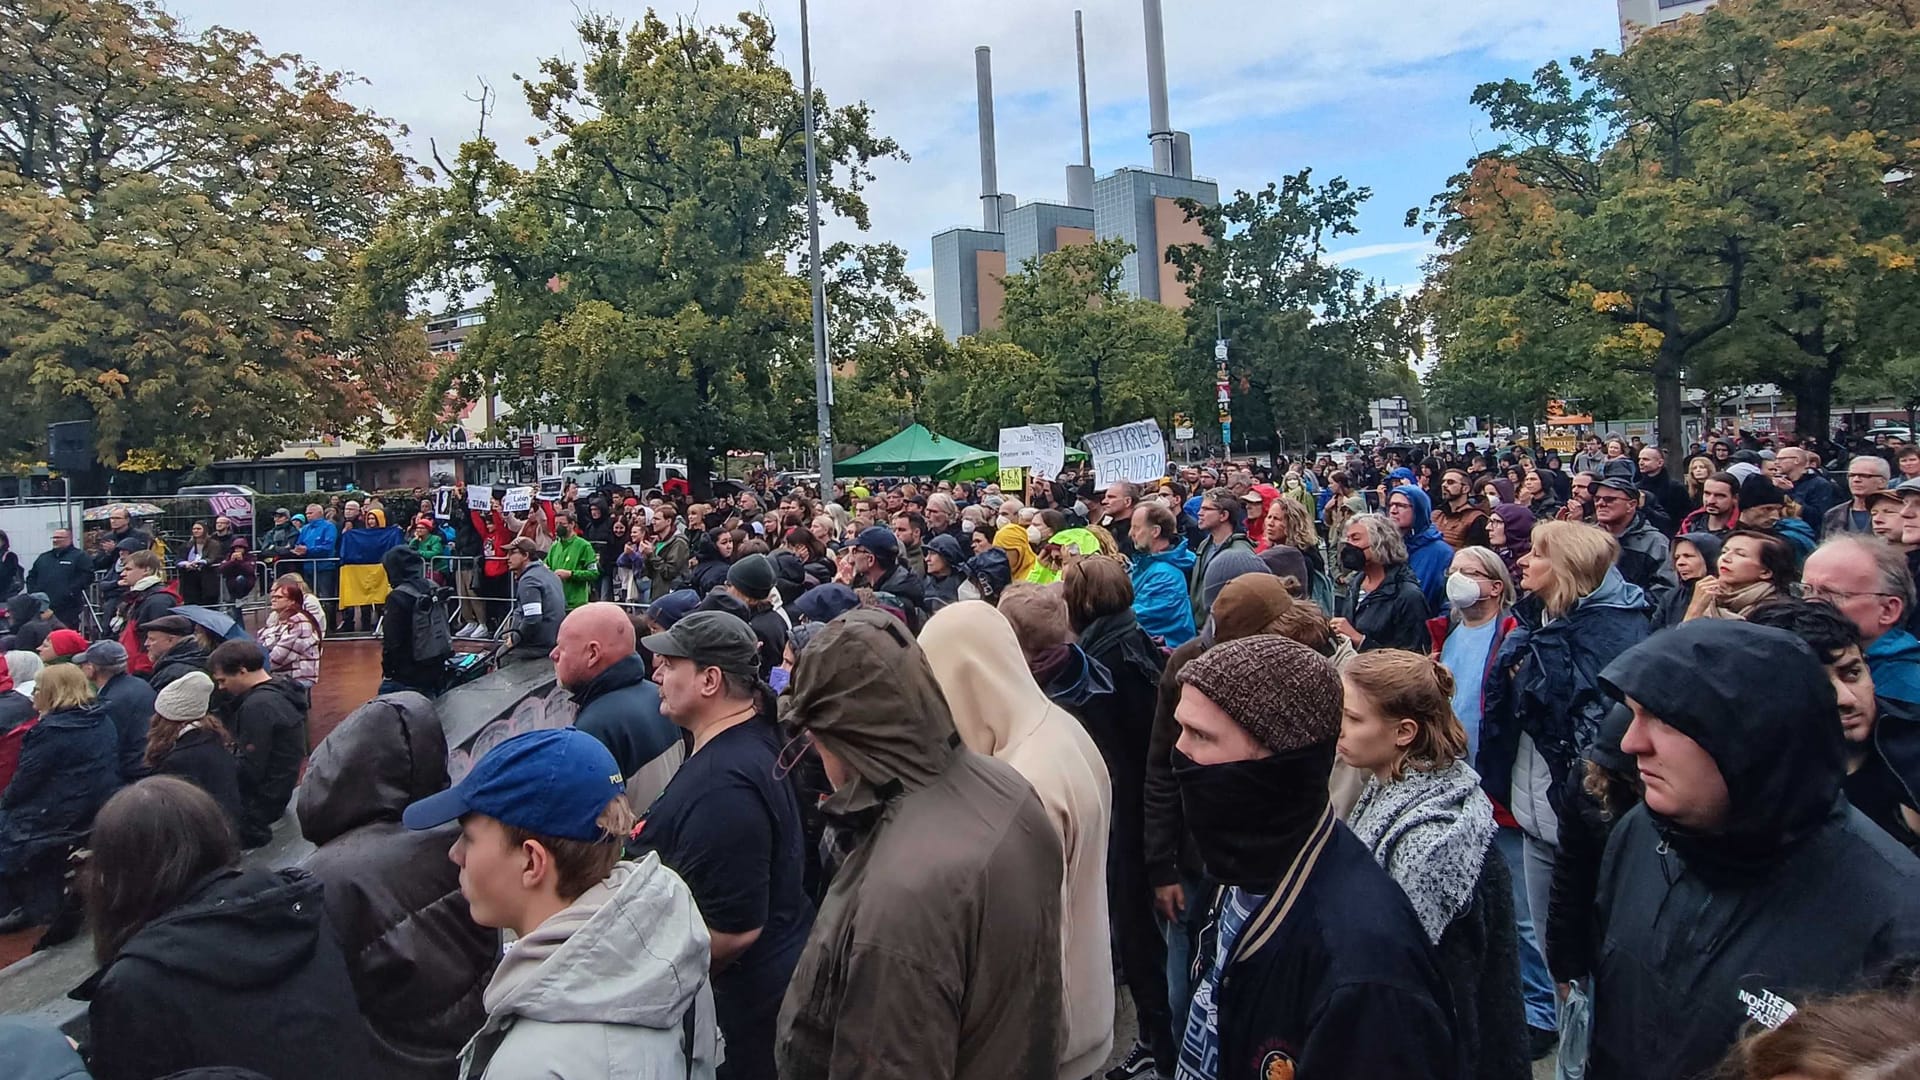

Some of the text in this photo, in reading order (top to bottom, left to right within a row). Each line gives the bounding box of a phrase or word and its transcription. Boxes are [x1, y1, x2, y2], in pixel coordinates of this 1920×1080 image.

[1086, 423, 1160, 455] WELTKRIEG
[1001, 468, 1020, 480] FCK
[1099, 453, 1163, 484] VERHINDERN
[1738, 990, 1781, 1017] NORTH
[1762, 988, 1785, 1009] THE
[1746, 1006, 1777, 1030] FACE
